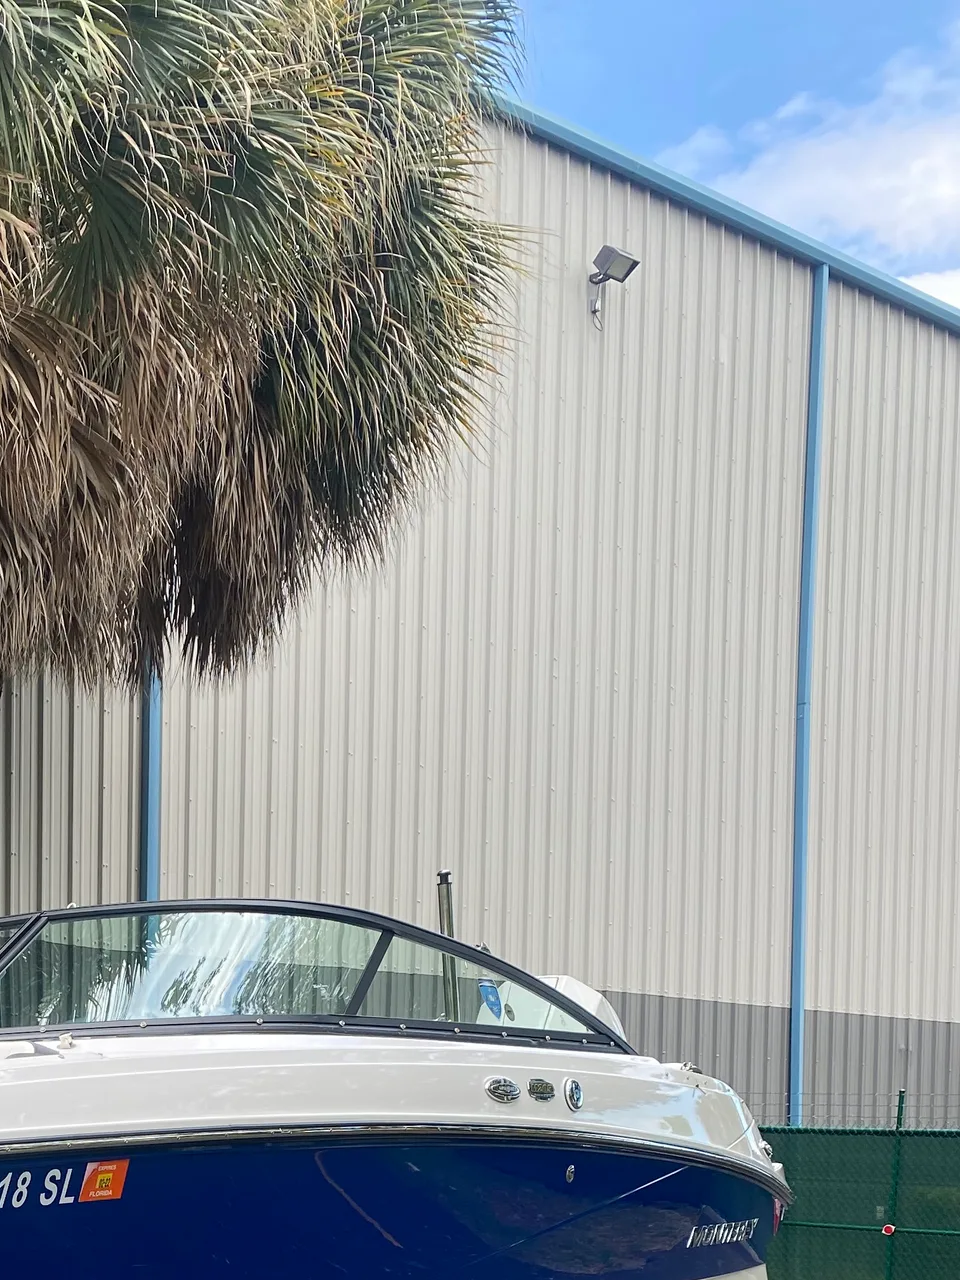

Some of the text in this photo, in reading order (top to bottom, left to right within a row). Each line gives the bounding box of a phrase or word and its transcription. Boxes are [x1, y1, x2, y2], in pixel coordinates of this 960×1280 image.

[40, 1168, 75, 1206] SL
[88, 1189, 113, 1197] FLORIDA
[686, 1218, 759, 1248] MONTEREY
